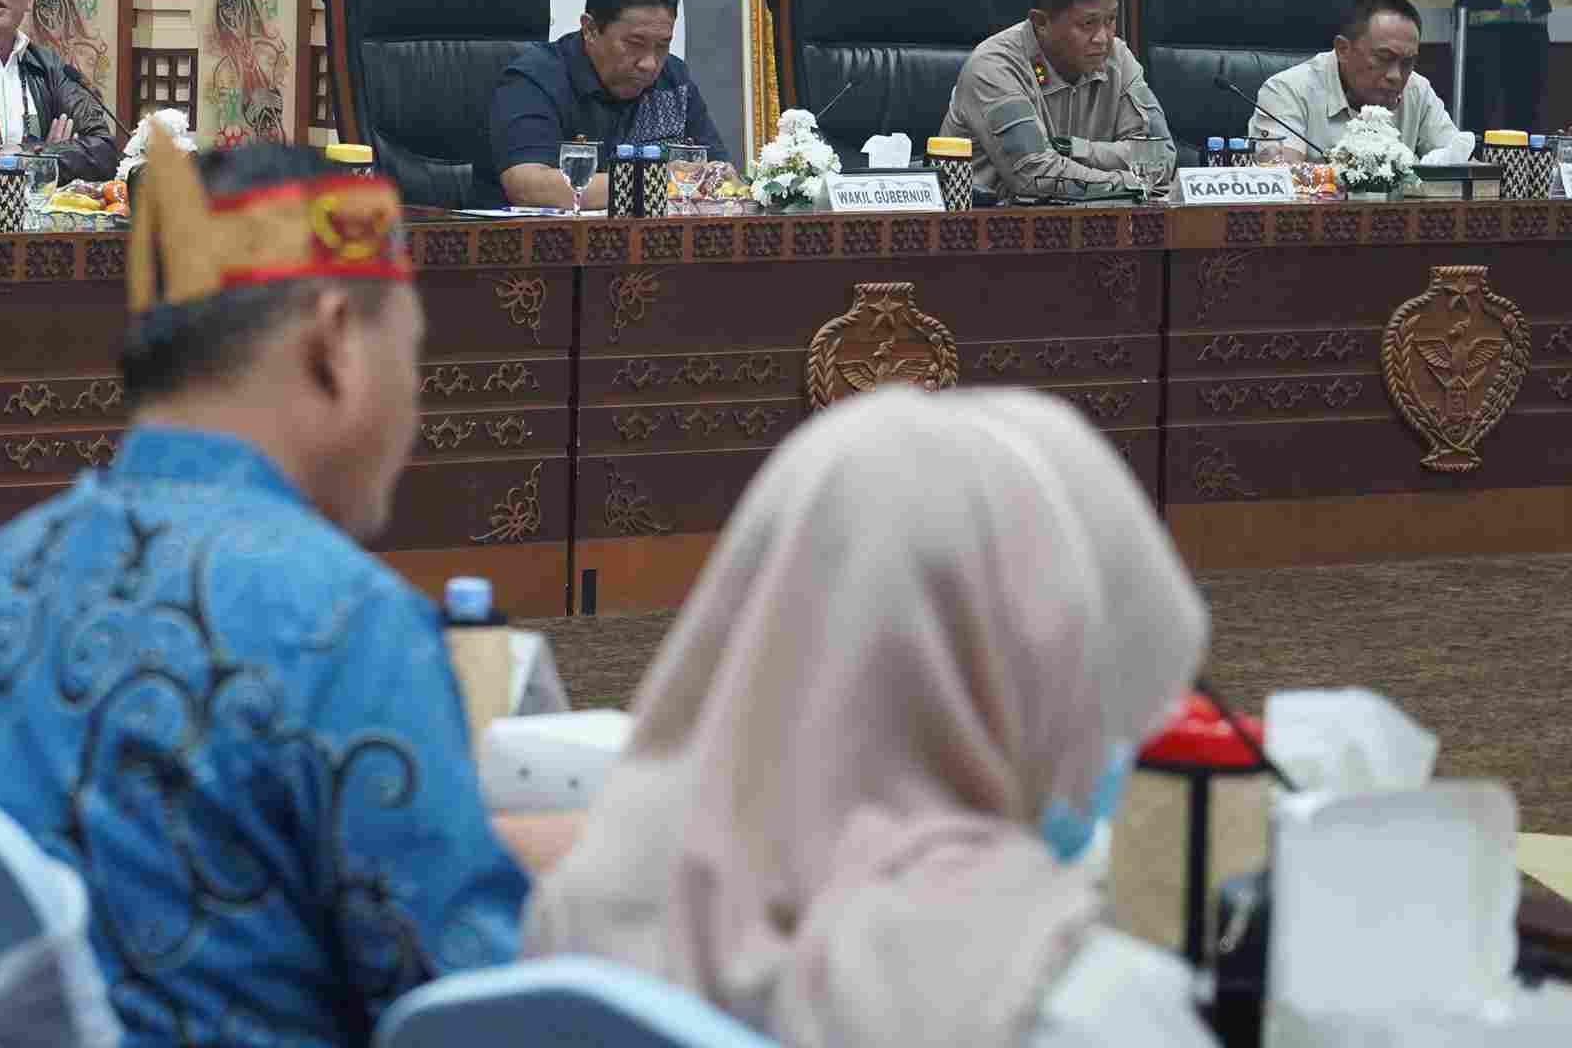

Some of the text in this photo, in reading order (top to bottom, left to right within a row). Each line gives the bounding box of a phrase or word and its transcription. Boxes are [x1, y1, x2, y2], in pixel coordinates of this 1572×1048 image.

[1190, 182, 1285, 196] KAPOLDA
[837, 189, 933, 204] WAKIL GUBERNUR
